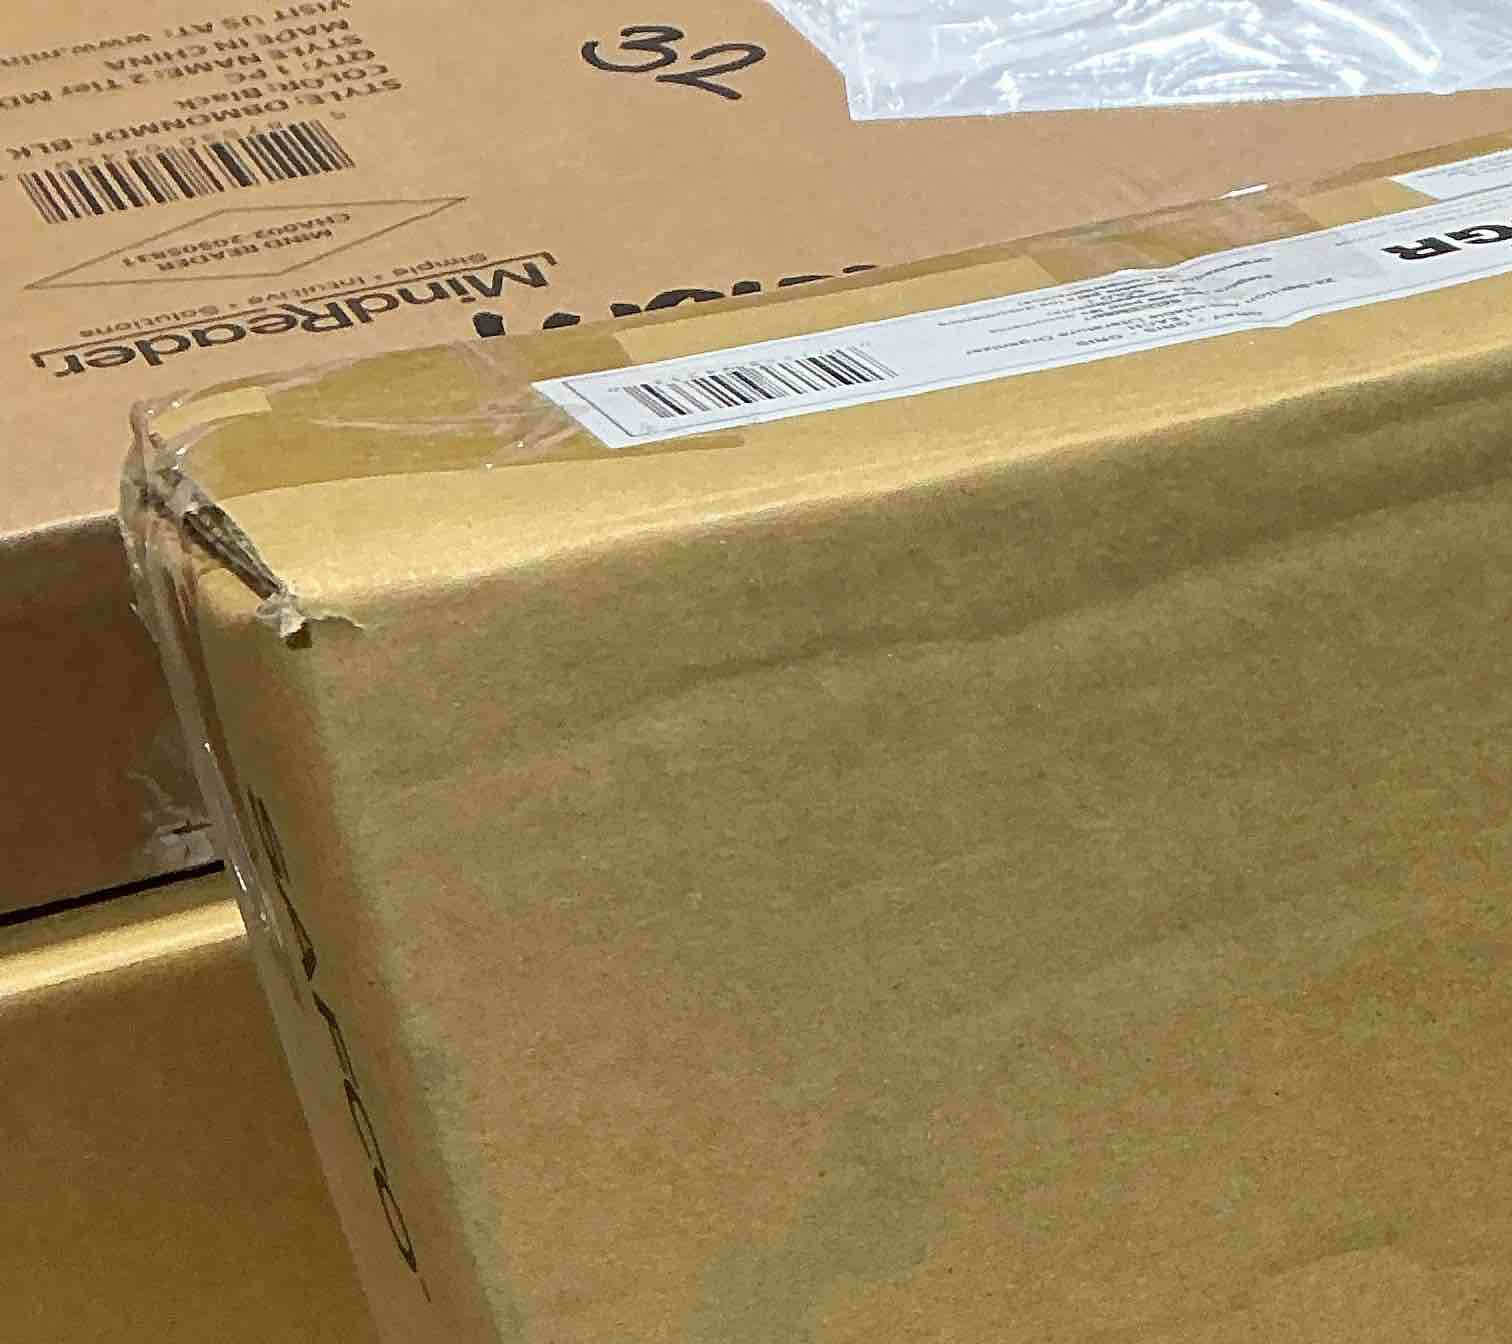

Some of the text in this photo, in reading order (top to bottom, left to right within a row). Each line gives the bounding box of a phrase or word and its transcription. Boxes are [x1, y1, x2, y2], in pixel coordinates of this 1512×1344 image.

[102, 17, 349, 71] MADE IN CHINA
[266, 32, 361, 59] STYLE
[58, 77, 120, 96] Tier
[171, 62, 387, 111] COLOR: Black
[294, 76, 402, 105] STYLE:
[155, 242, 258, 271] READER
[77, 251, 486, 339] Simple Intuitive Solutions
[51, 259, 547, 378] MindReader
